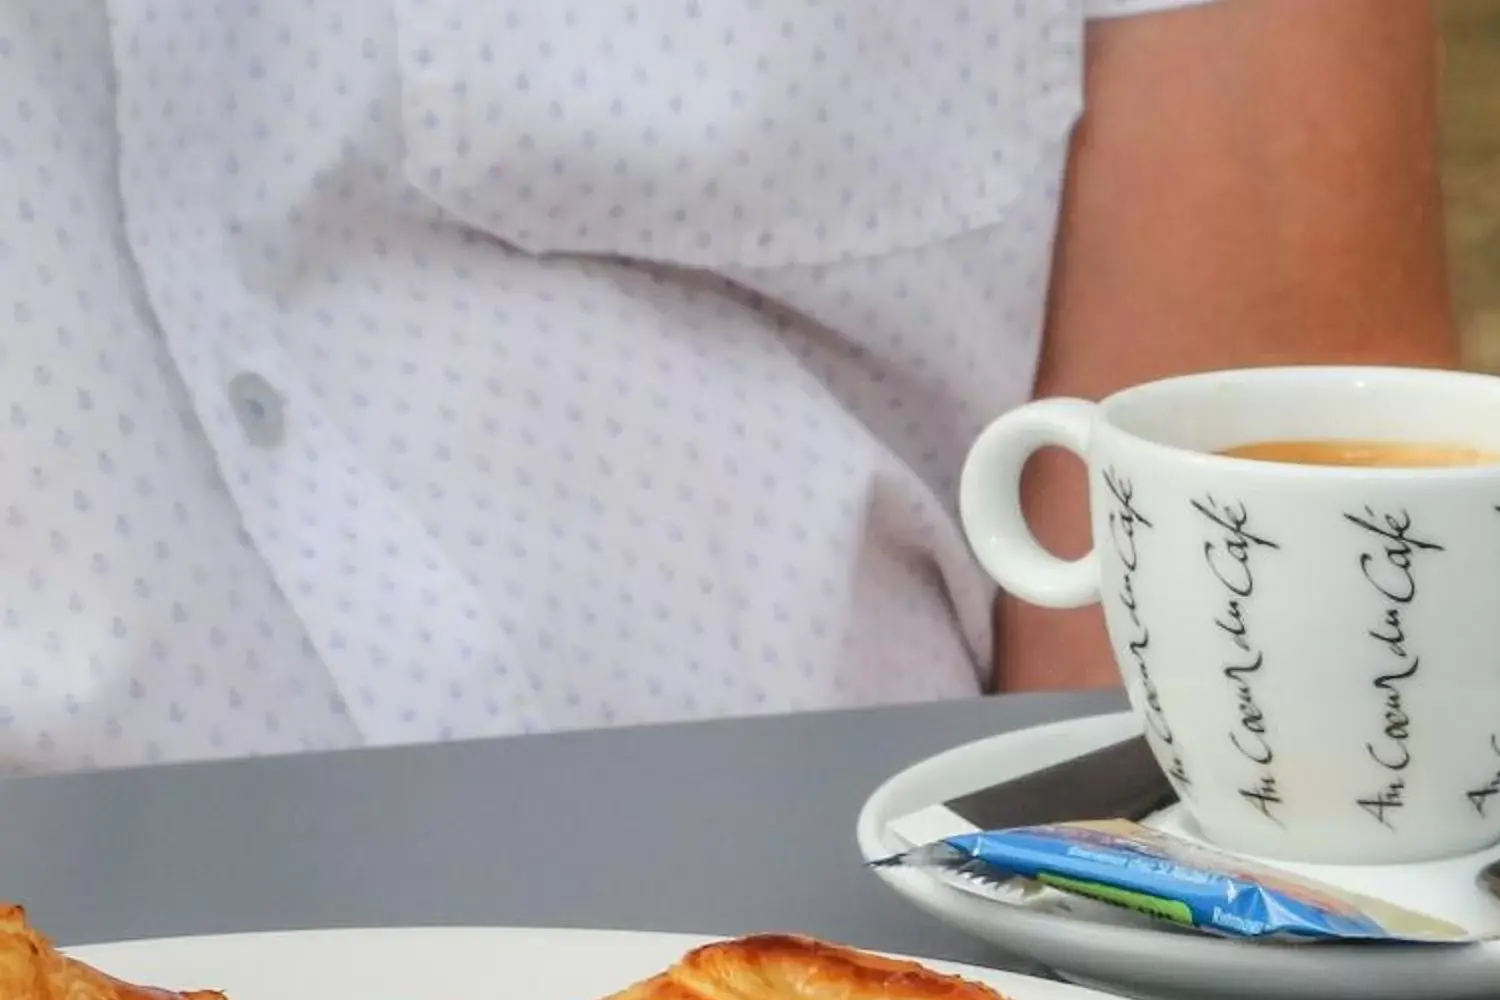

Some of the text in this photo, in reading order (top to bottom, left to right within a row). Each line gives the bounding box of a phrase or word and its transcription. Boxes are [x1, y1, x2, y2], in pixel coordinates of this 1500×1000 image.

[1190, 493, 1281, 597] Café
[1342, 505, 1446, 605] Café
[1214, 598, 1251, 653] du
[1368, 607, 1408, 659] du
[1238, 772, 1287, 826] Au
[1355, 777, 1405, 831] Au
